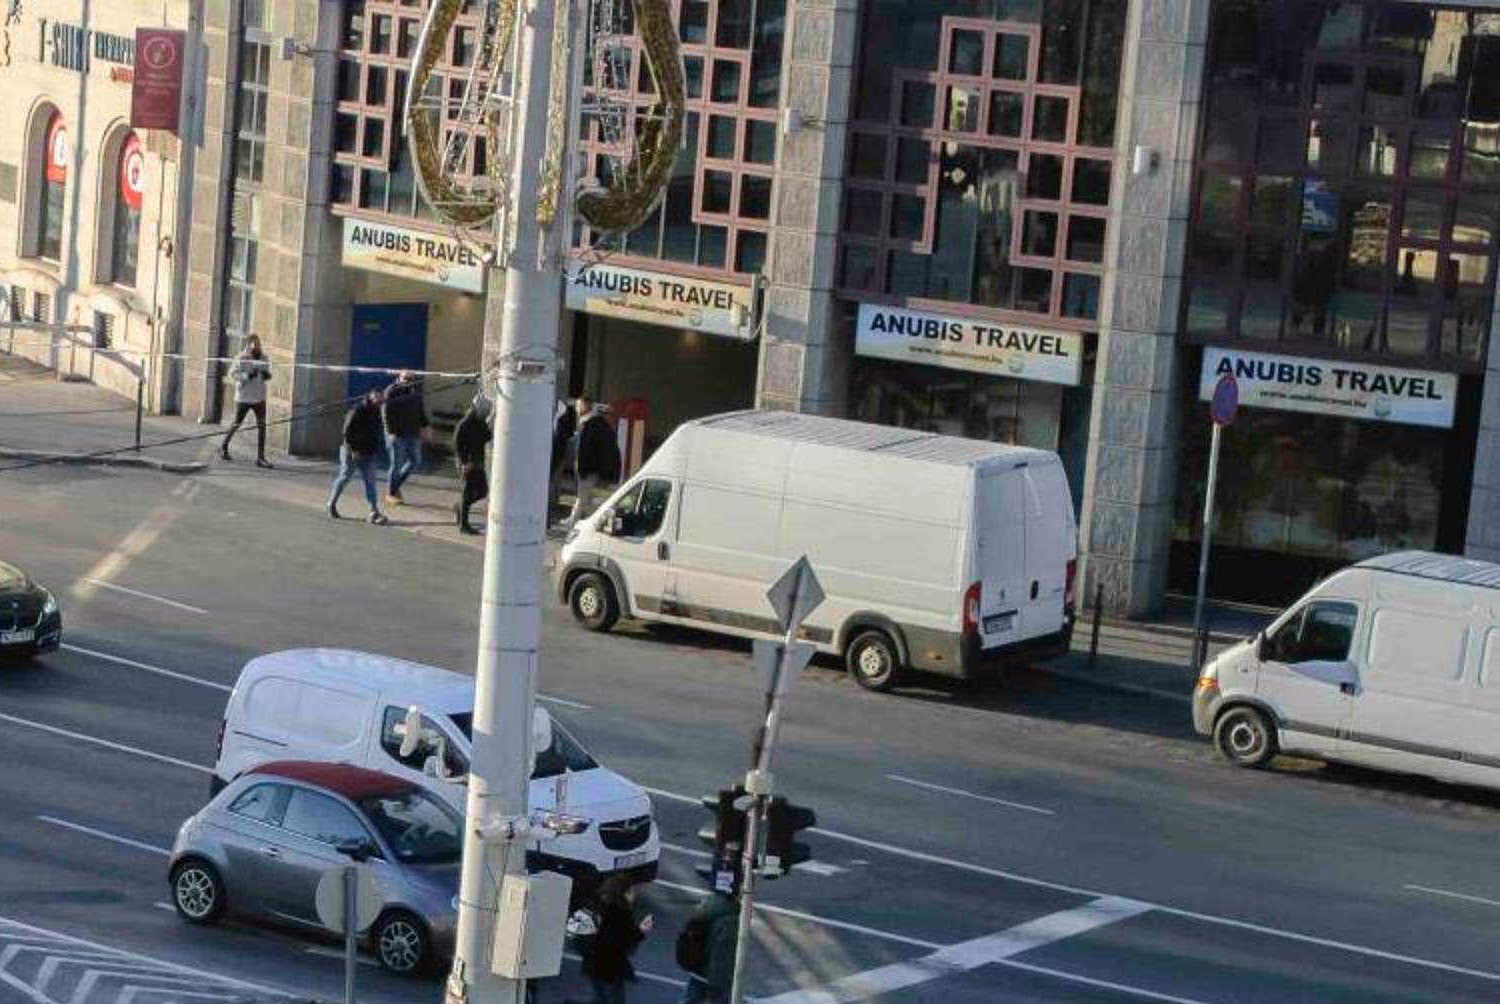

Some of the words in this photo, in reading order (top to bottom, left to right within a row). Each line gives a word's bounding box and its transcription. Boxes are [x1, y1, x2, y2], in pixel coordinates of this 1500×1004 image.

[38, 18, 93, 74] T-SHIRT
[351, 225, 411, 253] ANUBIS
[415, 238, 477, 267] TRAVEL
[575, 268, 653, 297] ANUBIS
[870, 312, 964, 342] ANUBIS
[972, 326, 1069, 357] TRAVEL
[1216, 357, 1323, 387] ANUBIS
[1332, 369, 1443, 400] TRAVEL
